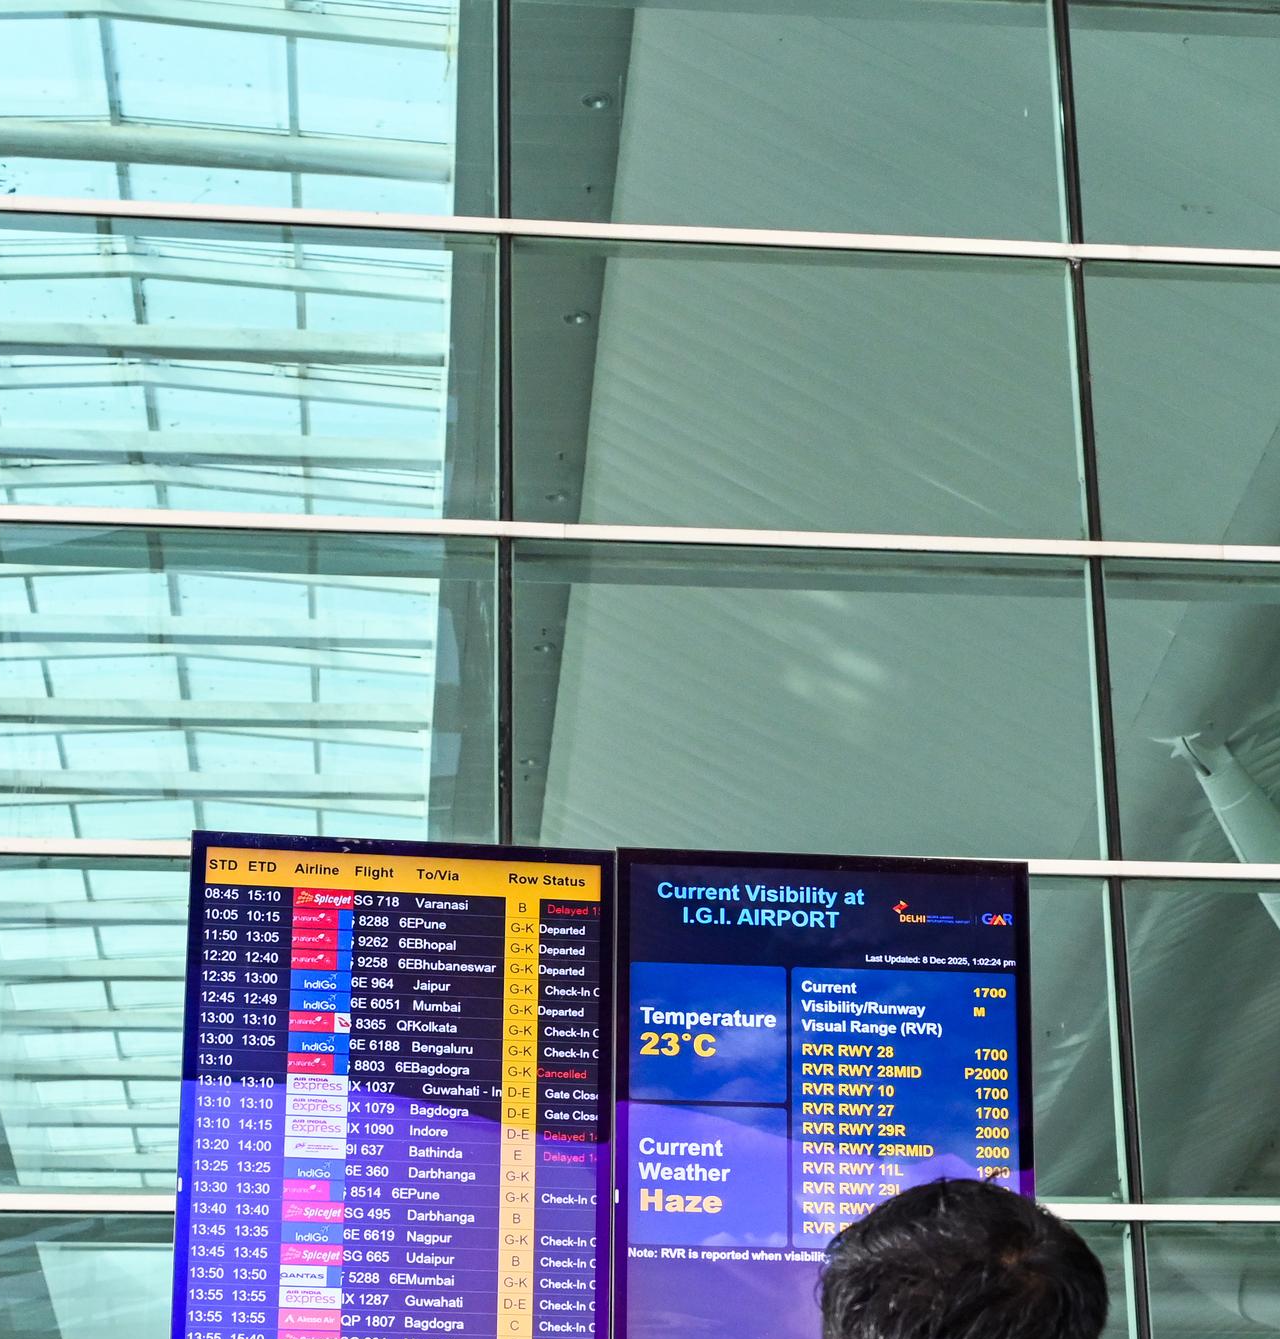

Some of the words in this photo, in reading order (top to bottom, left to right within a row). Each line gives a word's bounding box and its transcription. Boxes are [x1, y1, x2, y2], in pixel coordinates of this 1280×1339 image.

[209, 859, 238, 871] STD
[248, 861, 277, 872] ETD
[294, 863, 339, 875] Airline
[355, 866, 394, 880] Flight
[416, 868, 459, 881] To/Via
[508, 873, 538, 884] Row
[543, 875, 585, 887] Status
[205, 888, 239, 900] 08:45
[248, 890, 281, 902] 15:10
[353, 895, 373, 906] SG
[377, 896, 399, 907] 718
[415, 897, 468, 910] Varanasi
[518, 902, 527, 913] B
[548, 904, 589, 916] Delayed
[657, 882, 740, 901] Current
[745, 885, 838, 908] Visibility
[844, 889, 865, 905] at
[683, 907, 731, 925] I.G.I.
[737, 908, 840, 928] AIRPORT
[900, 914, 926, 923] DELHI
[865, 954, 883, 962] Last
[884, 955, 921, 965] Updated:
[922, 956, 928, 964] 8
[929, 956, 946, 964] Dec
[947, 957, 970, 966] 2025,
[972, 958, 1001, 966] 1:02:24
[1003, 960, 1016, 968] pm
[202, 970, 236, 982] 12:35
[244, 972, 278, 984] 13:00
[351, 977, 368, 989] 6E
[371, 977, 394, 989] 964
[413, 979, 451, 993] Jaipur
[509, 983, 533, 994] G-K
[545, 985, 590, 997] Check-In
[801, 980, 857, 994] Current
[973, 987, 1007, 998] 1700
[202, 991, 235, 1003] 12:45
[244, 993, 277, 1005] 12:49
[350, 997, 367, 1009] 6E
[370, 998, 399, 1010] 6051
[413, 1000, 461, 1012] Mumbai
[509, 1004, 533, 1015] G-K
[538, 1005, 585, 1018] Departed
[801, 999, 926, 1018] Visibility/Runway
[973, 1007, 986, 1017] M
[640, 1007, 777, 1030] Temperature
[801, 1019, 845, 1032] Visual
[849, 1021, 897, 1037] Range
[901, 1022, 942, 1038] (RVR)
[200, 1033, 233, 1045] 13:00
[242, 1034, 275, 1046] 13:05
[349, 1039, 366, 1051] 6E
[369, 1040, 400, 1051] 6188
[412, 1041, 473, 1056] Bengaluru
[508, 1045, 532, 1056] G-K
[544, 1047, 590, 1058] Check-In
[640, 1032, 716, 1057] 23°C
[802, 1043, 834, 1056] RVR
[838, 1044, 873, 1057] RWY
[877, 1046, 894, 1058] 28
[975, 1048, 1008, 1061] 1700
[802, 1063, 834, 1076] RVR
[838, 1064, 873, 1077] RWY
[877, 1065, 922, 1078] 28MID
[964, 1067, 1008, 1080] P2000
[802, 1082, 834, 1096] RVR
[838, 1083, 874, 1096] RWY
[878, 1085, 895, 1097] 10
[975, 1087, 1009, 1100] 1700
[802, 1102, 834, 1115] RVR
[838, 1103, 874, 1116] RWY
[877, 1104, 895, 1117] 27
[976, 1107, 1009, 1120] 1700
[803, 1122, 835, 1135] RVR
[838, 1122, 874, 1136] RWY
[878, 1124, 906, 1137] 29R
[976, 1126, 1010, 1139] 2000
[639, 1137, 723, 1157] Current
[803, 1141, 835, 1155] RVR
[839, 1142, 874, 1155] RWY
[878, 1143, 934, 1157] 29RMID
[976, 1146, 1010, 1159] 2000
[638, 1162, 731, 1182] Weather
[802, 1162, 835, 1175] RVR
[839, 1162, 874, 1175] RWY
[879, 1164, 904, 1176] 11L
[803, 1181, 835, 1194] RVR
[839, 1182, 875, 1195] RWY
[640, 1188, 723, 1213] Haze
[803, 1201, 835, 1214] RVR
[839, 1202, 876, 1215] RWY
[803, 1221, 835, 1234] RVR
[628, 1247, 658, 1258] Note:
[661, 1248, 686, 1259] RVR
[688, 1248, 699, 1259] is
[701, 1250, 749, 1262] reported
[751, 1250, 782, 1261] when
